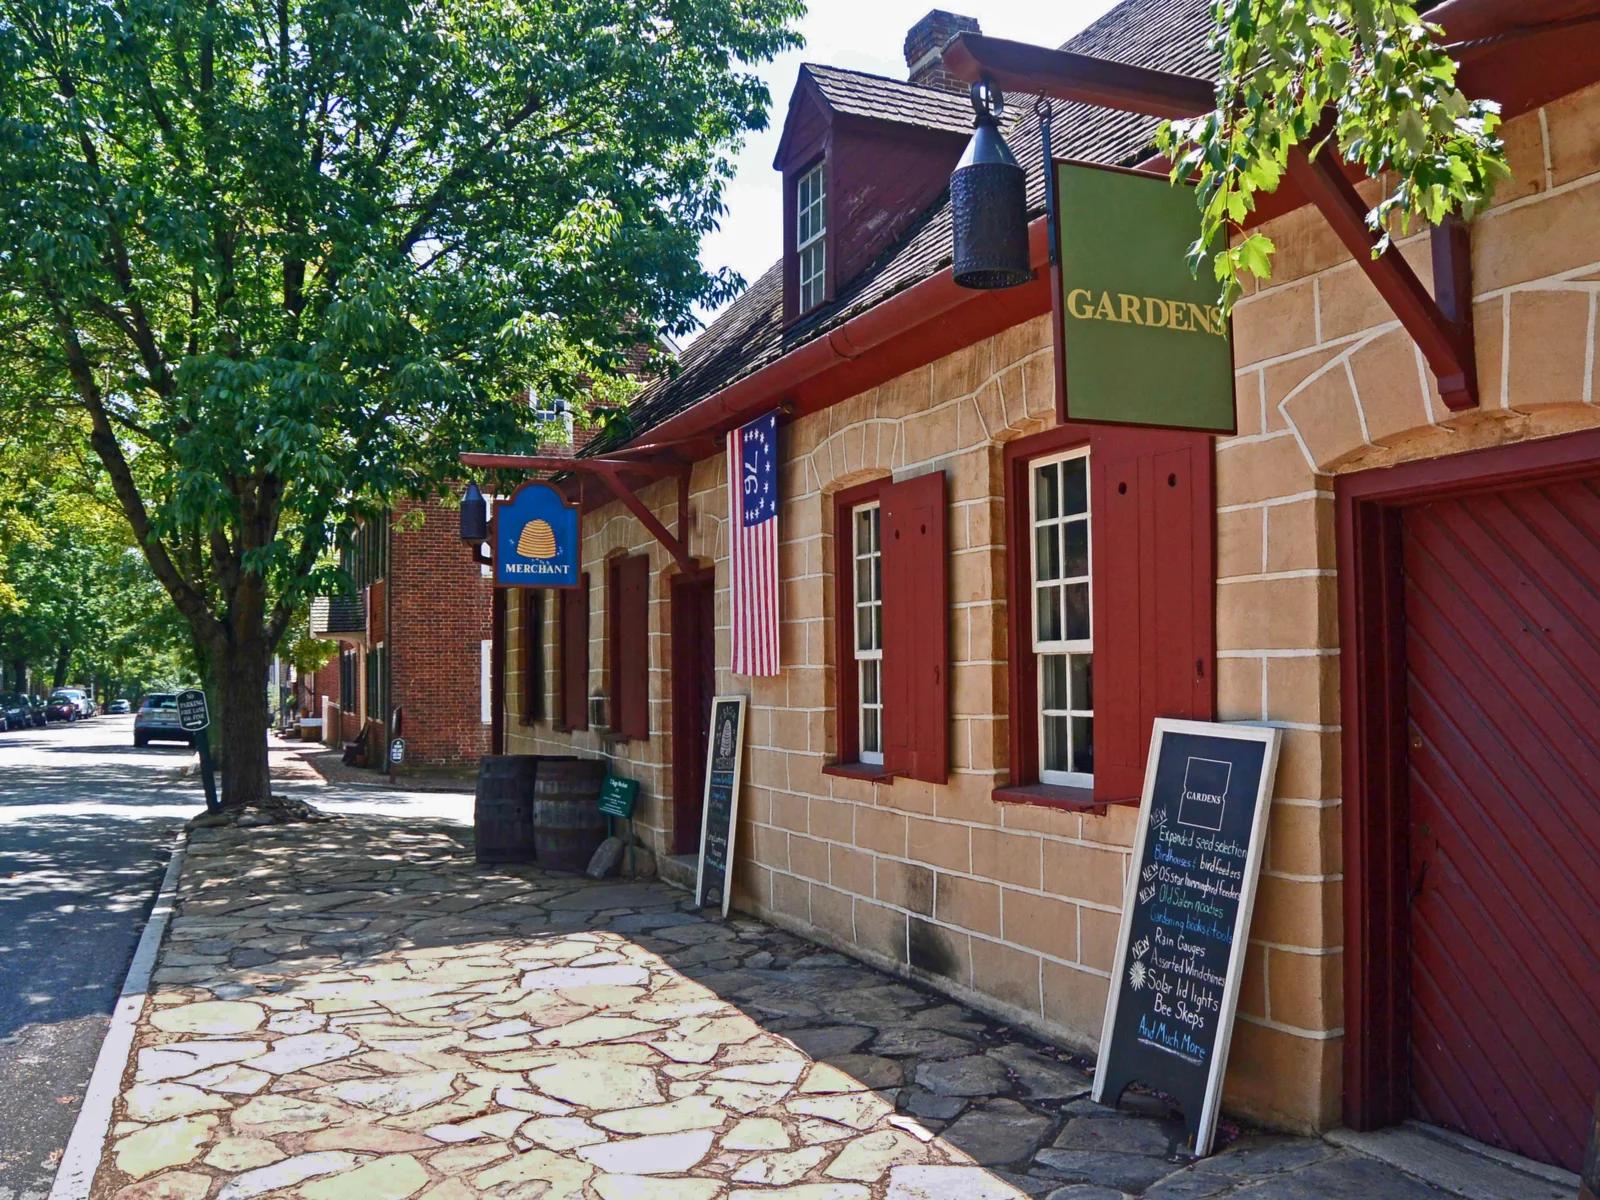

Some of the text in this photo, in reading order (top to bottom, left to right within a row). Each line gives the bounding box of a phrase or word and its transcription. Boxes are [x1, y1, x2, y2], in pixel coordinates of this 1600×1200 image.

[1067, 288, 1227, 336] GARDENS
[744, 451, 758, 495] 76
[505, 563, 570, 574] MERCHANT
[180, 700, 203, 709] PARKING
[192, 706, 205, 714] LANE
[1186, 791, 1221, 805] GARDENS
[1150, 805, 1167, 827] NEW
[1159, 825, 1248, 859] Expanded seed selection
[1154, 844, 1191, 868] Birdhouses
[1142, 861, 1159, 882] NEW
[1139, 883, 1156, 903] NEW
[1159, 884, 1173, 905] Old
[1172, 888, 1194, 909] Salem
[1150, 903, 1185, 934] Gardening
[1186, 914, 1206, 934] books
[1211, 921, 1233, 944] tools
[1132, 935, 1150, 959] NEW
[1155, 927, 1206, 960] Rain Gauges
[1151, 947, 1184, 973] Assorted
[1148, 968, 1172, 995] Solar
[1191, 983, 1219, 1013] lights
[1154, 993, 1204, 1030] Bee Skeps
[1138, 1013, 1206, 1059] And Much More
